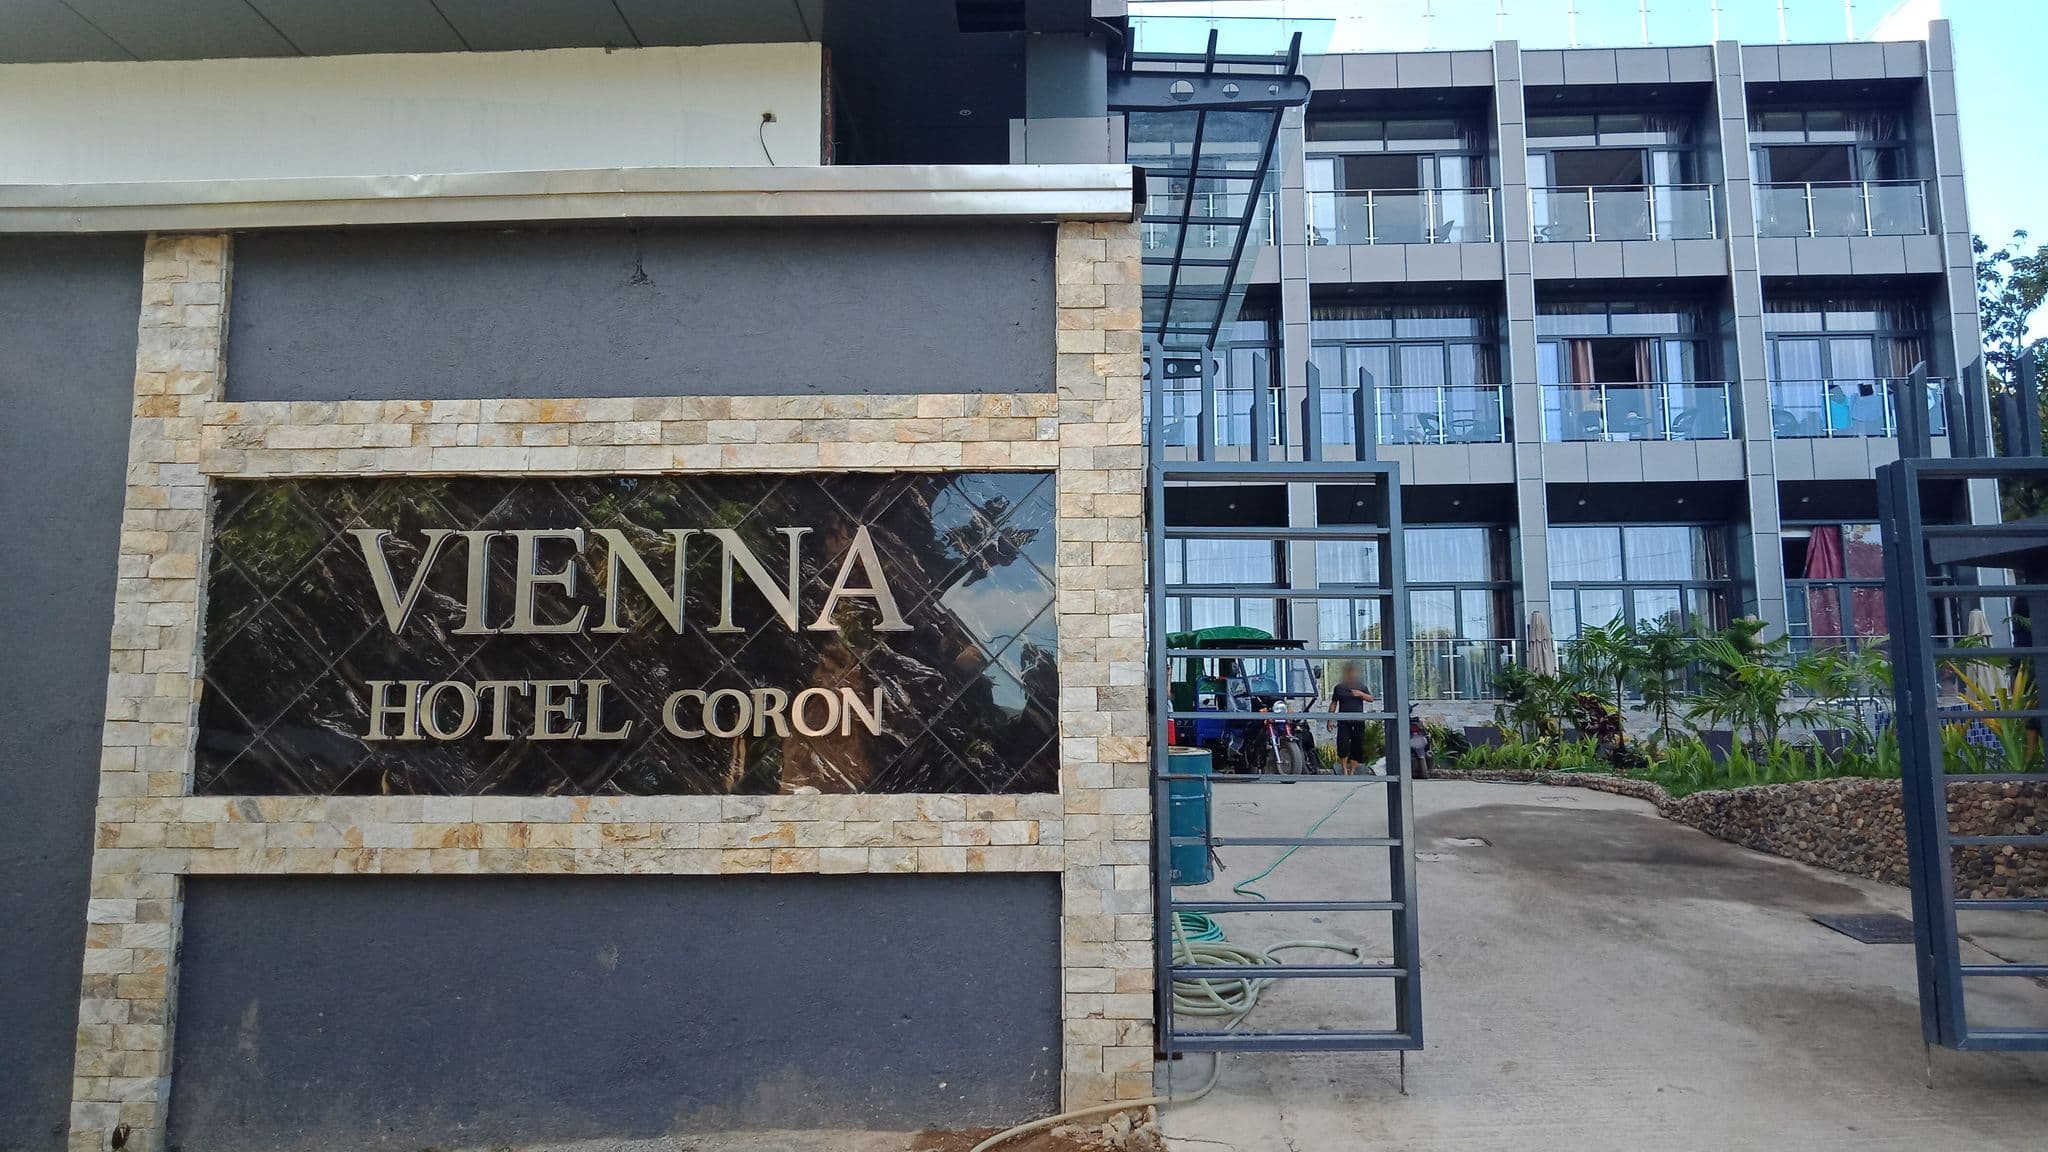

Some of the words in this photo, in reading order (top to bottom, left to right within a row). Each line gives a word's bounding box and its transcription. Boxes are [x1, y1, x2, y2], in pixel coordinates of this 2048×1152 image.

[346, 524, 914, 634] VIENNA
[361, 679, 633, 741] HOTEL
[662, 687, 883, 739] CORON
